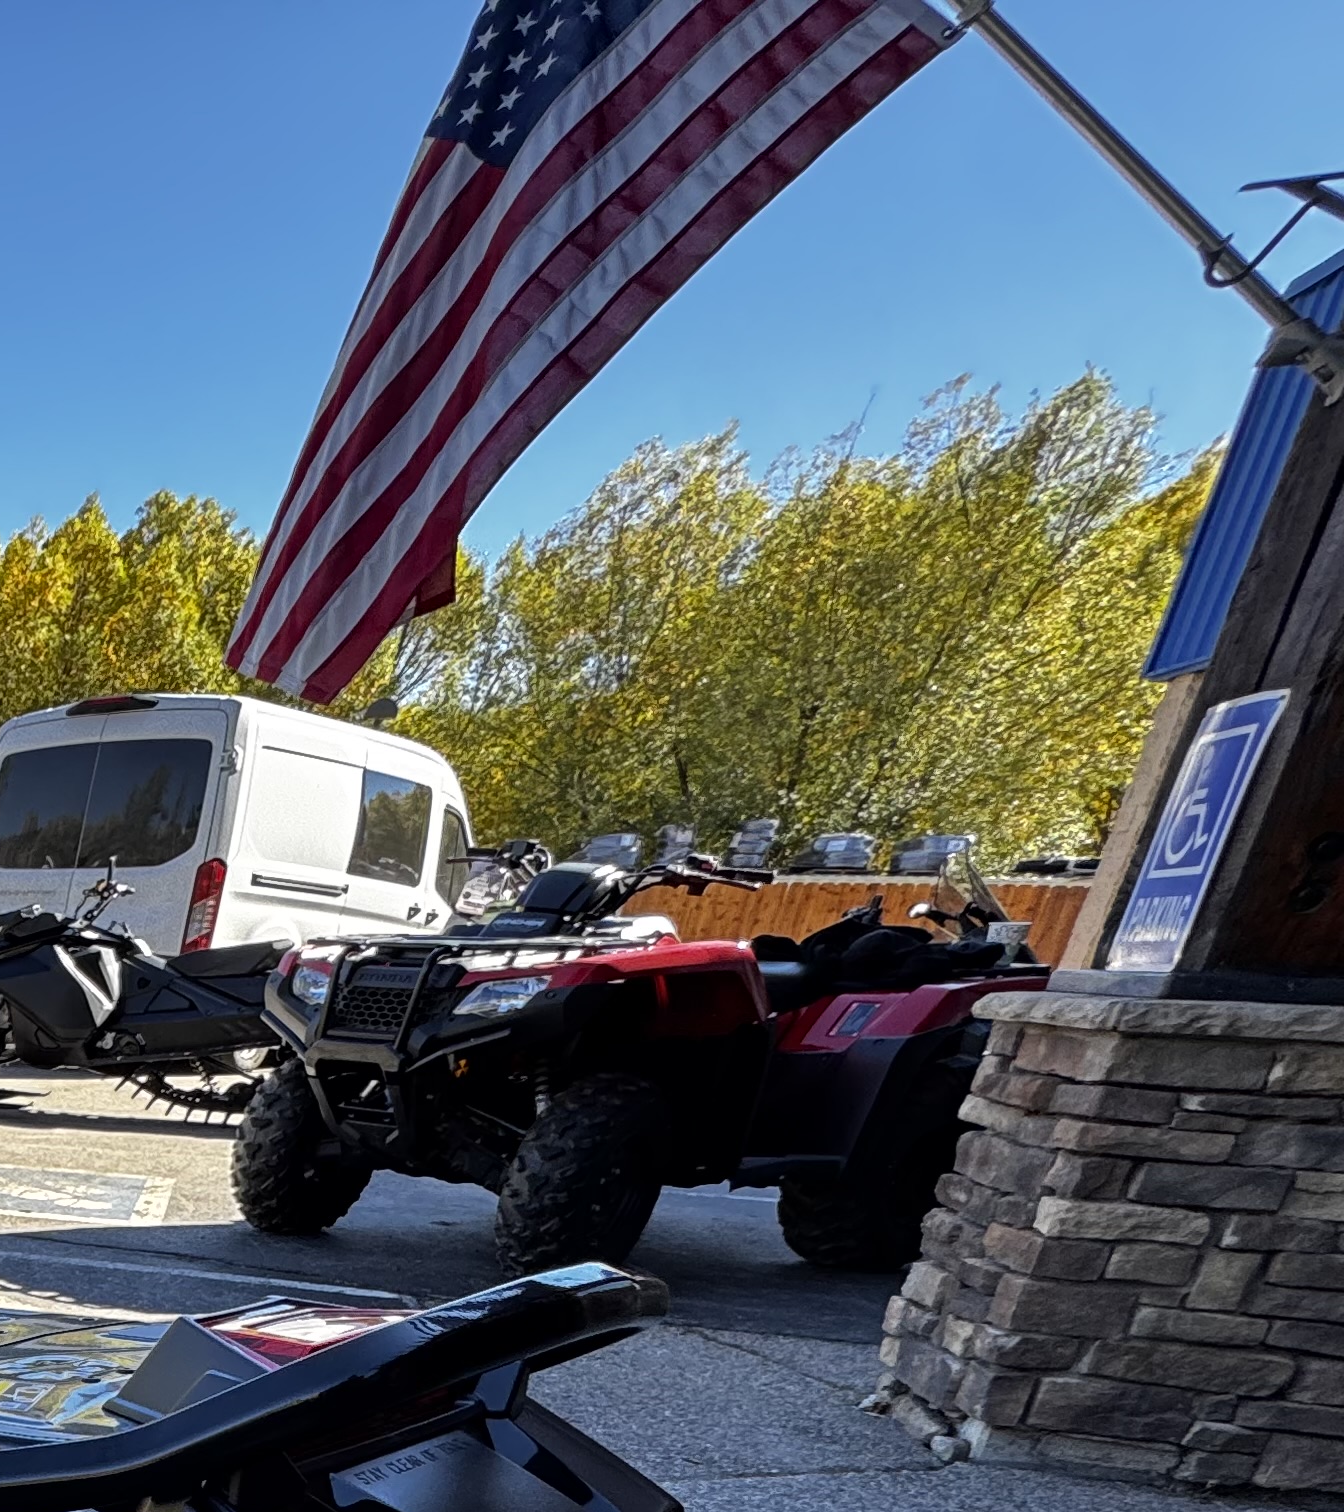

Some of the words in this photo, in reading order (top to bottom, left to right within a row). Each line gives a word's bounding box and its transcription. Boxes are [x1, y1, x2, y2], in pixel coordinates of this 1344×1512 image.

[1121, 893, 1193, 942] PARKING
[353, 1464, 389, 1486] STAY
[385, 1454, 427, 1475] CLEAR
